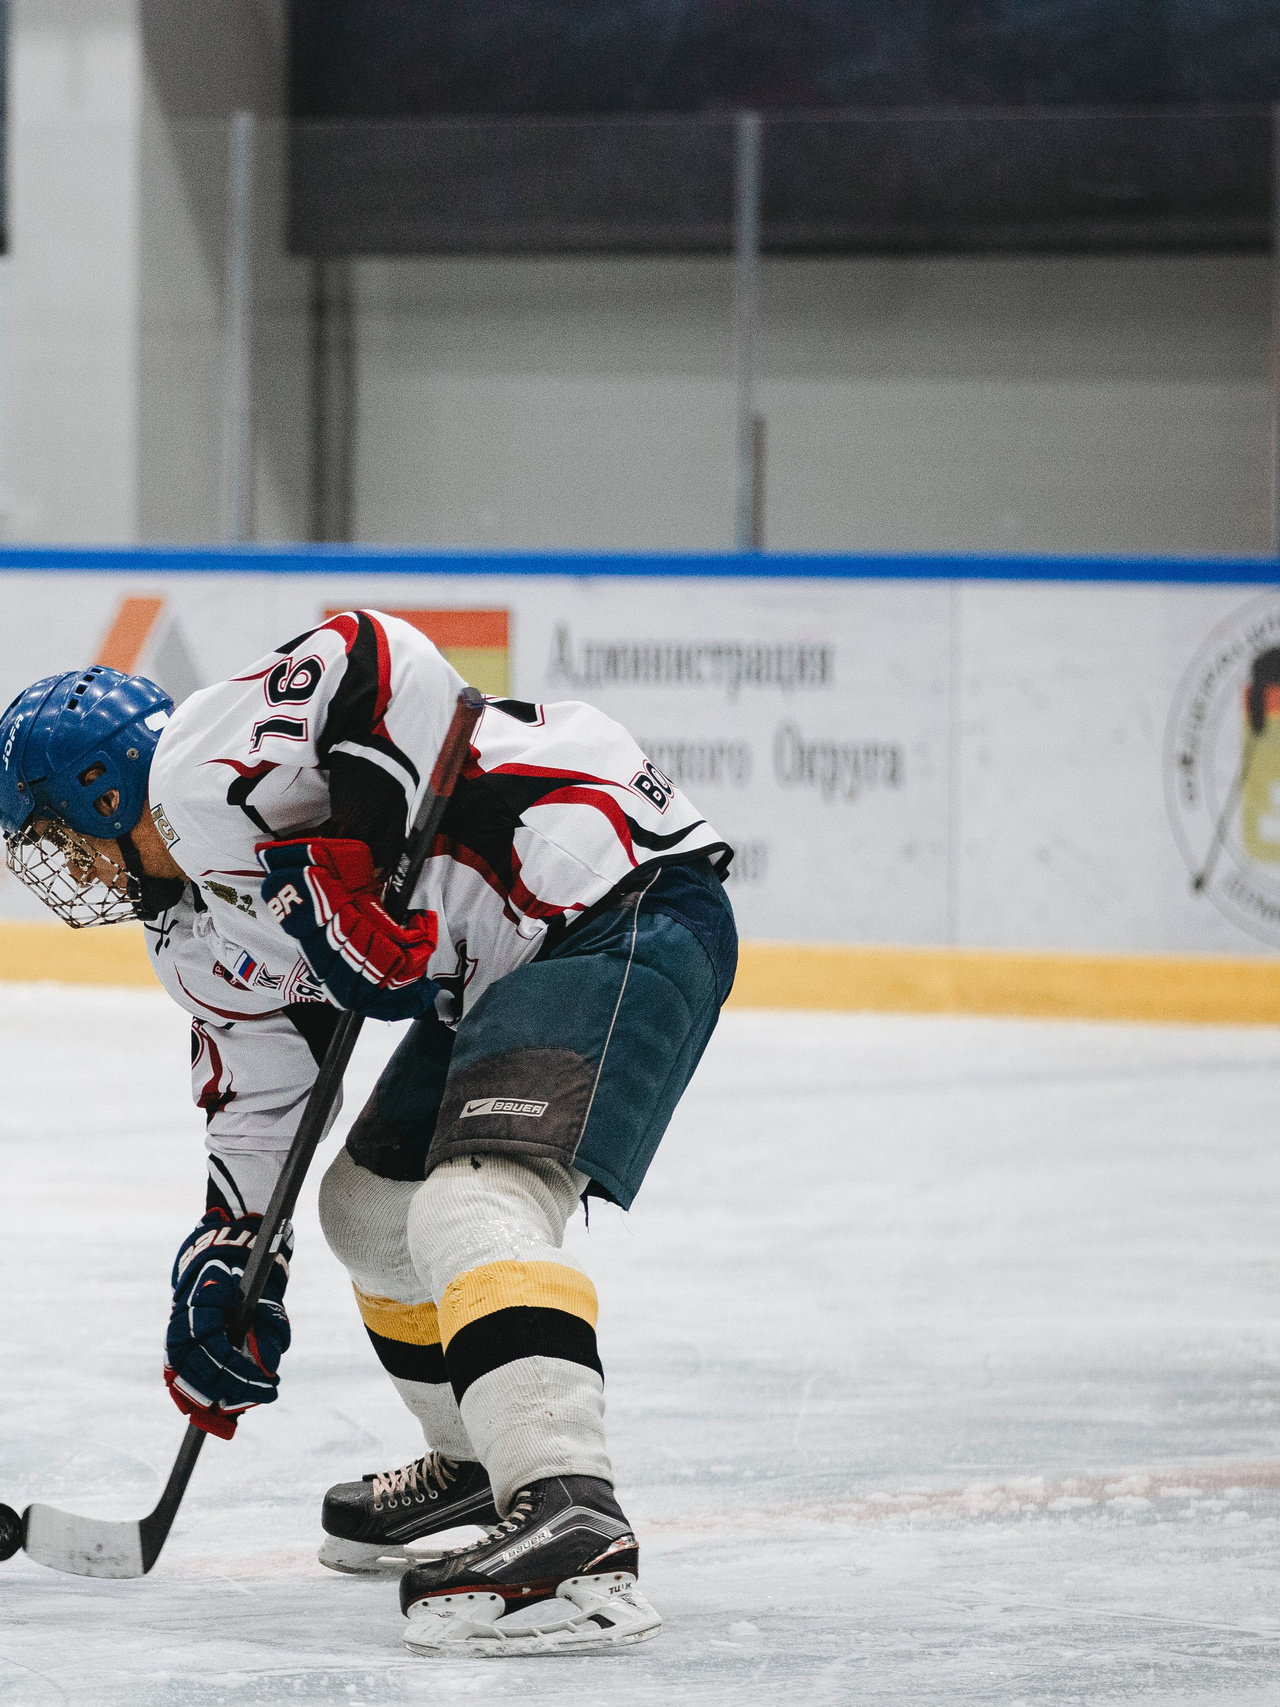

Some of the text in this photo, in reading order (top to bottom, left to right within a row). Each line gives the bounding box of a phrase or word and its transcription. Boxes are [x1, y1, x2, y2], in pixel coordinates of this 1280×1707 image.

[546, 621, 832, 697] Администрация
[249, 654, 326, 755] 16
[2, 713, 24, 771] JOFA
[494, 1100, 543, 1115] BAUER
[508, 1532, 546, 1558] BAUER
